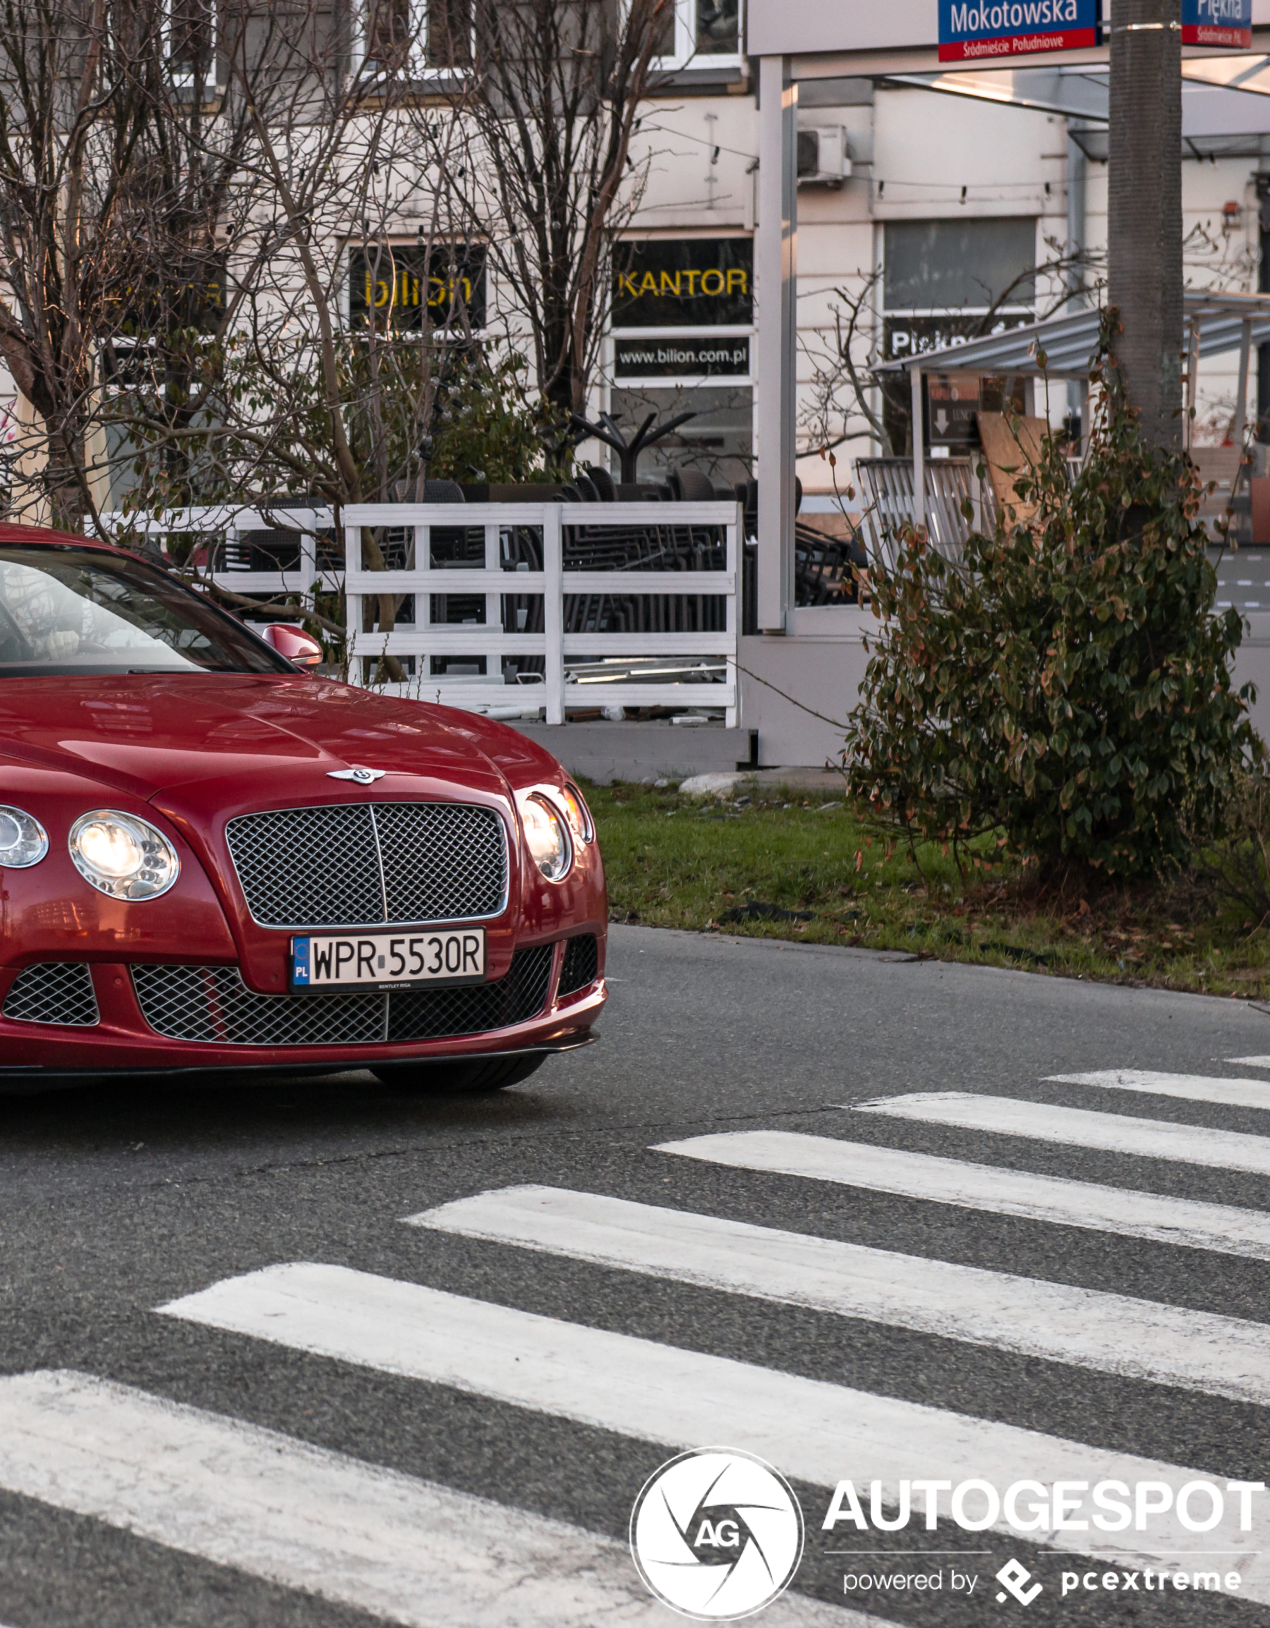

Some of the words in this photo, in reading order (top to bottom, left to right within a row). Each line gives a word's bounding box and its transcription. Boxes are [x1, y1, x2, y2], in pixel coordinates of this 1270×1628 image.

[951, 0, 1078, 33] Mokotowska
[963, 38, 1010, 57] Śródmieście
[1012, 35, 1064, 51] Południowe
[365, 270, 471, 307] bilion
[618, 268, 748, 297] KANTOR
[619, 347, 747, 366] www.bilion.com.pl
[296, 967, 308, 977] PL
[314, 940, 376, 979] WPR
[389, 935, 480, 976] 5530R
